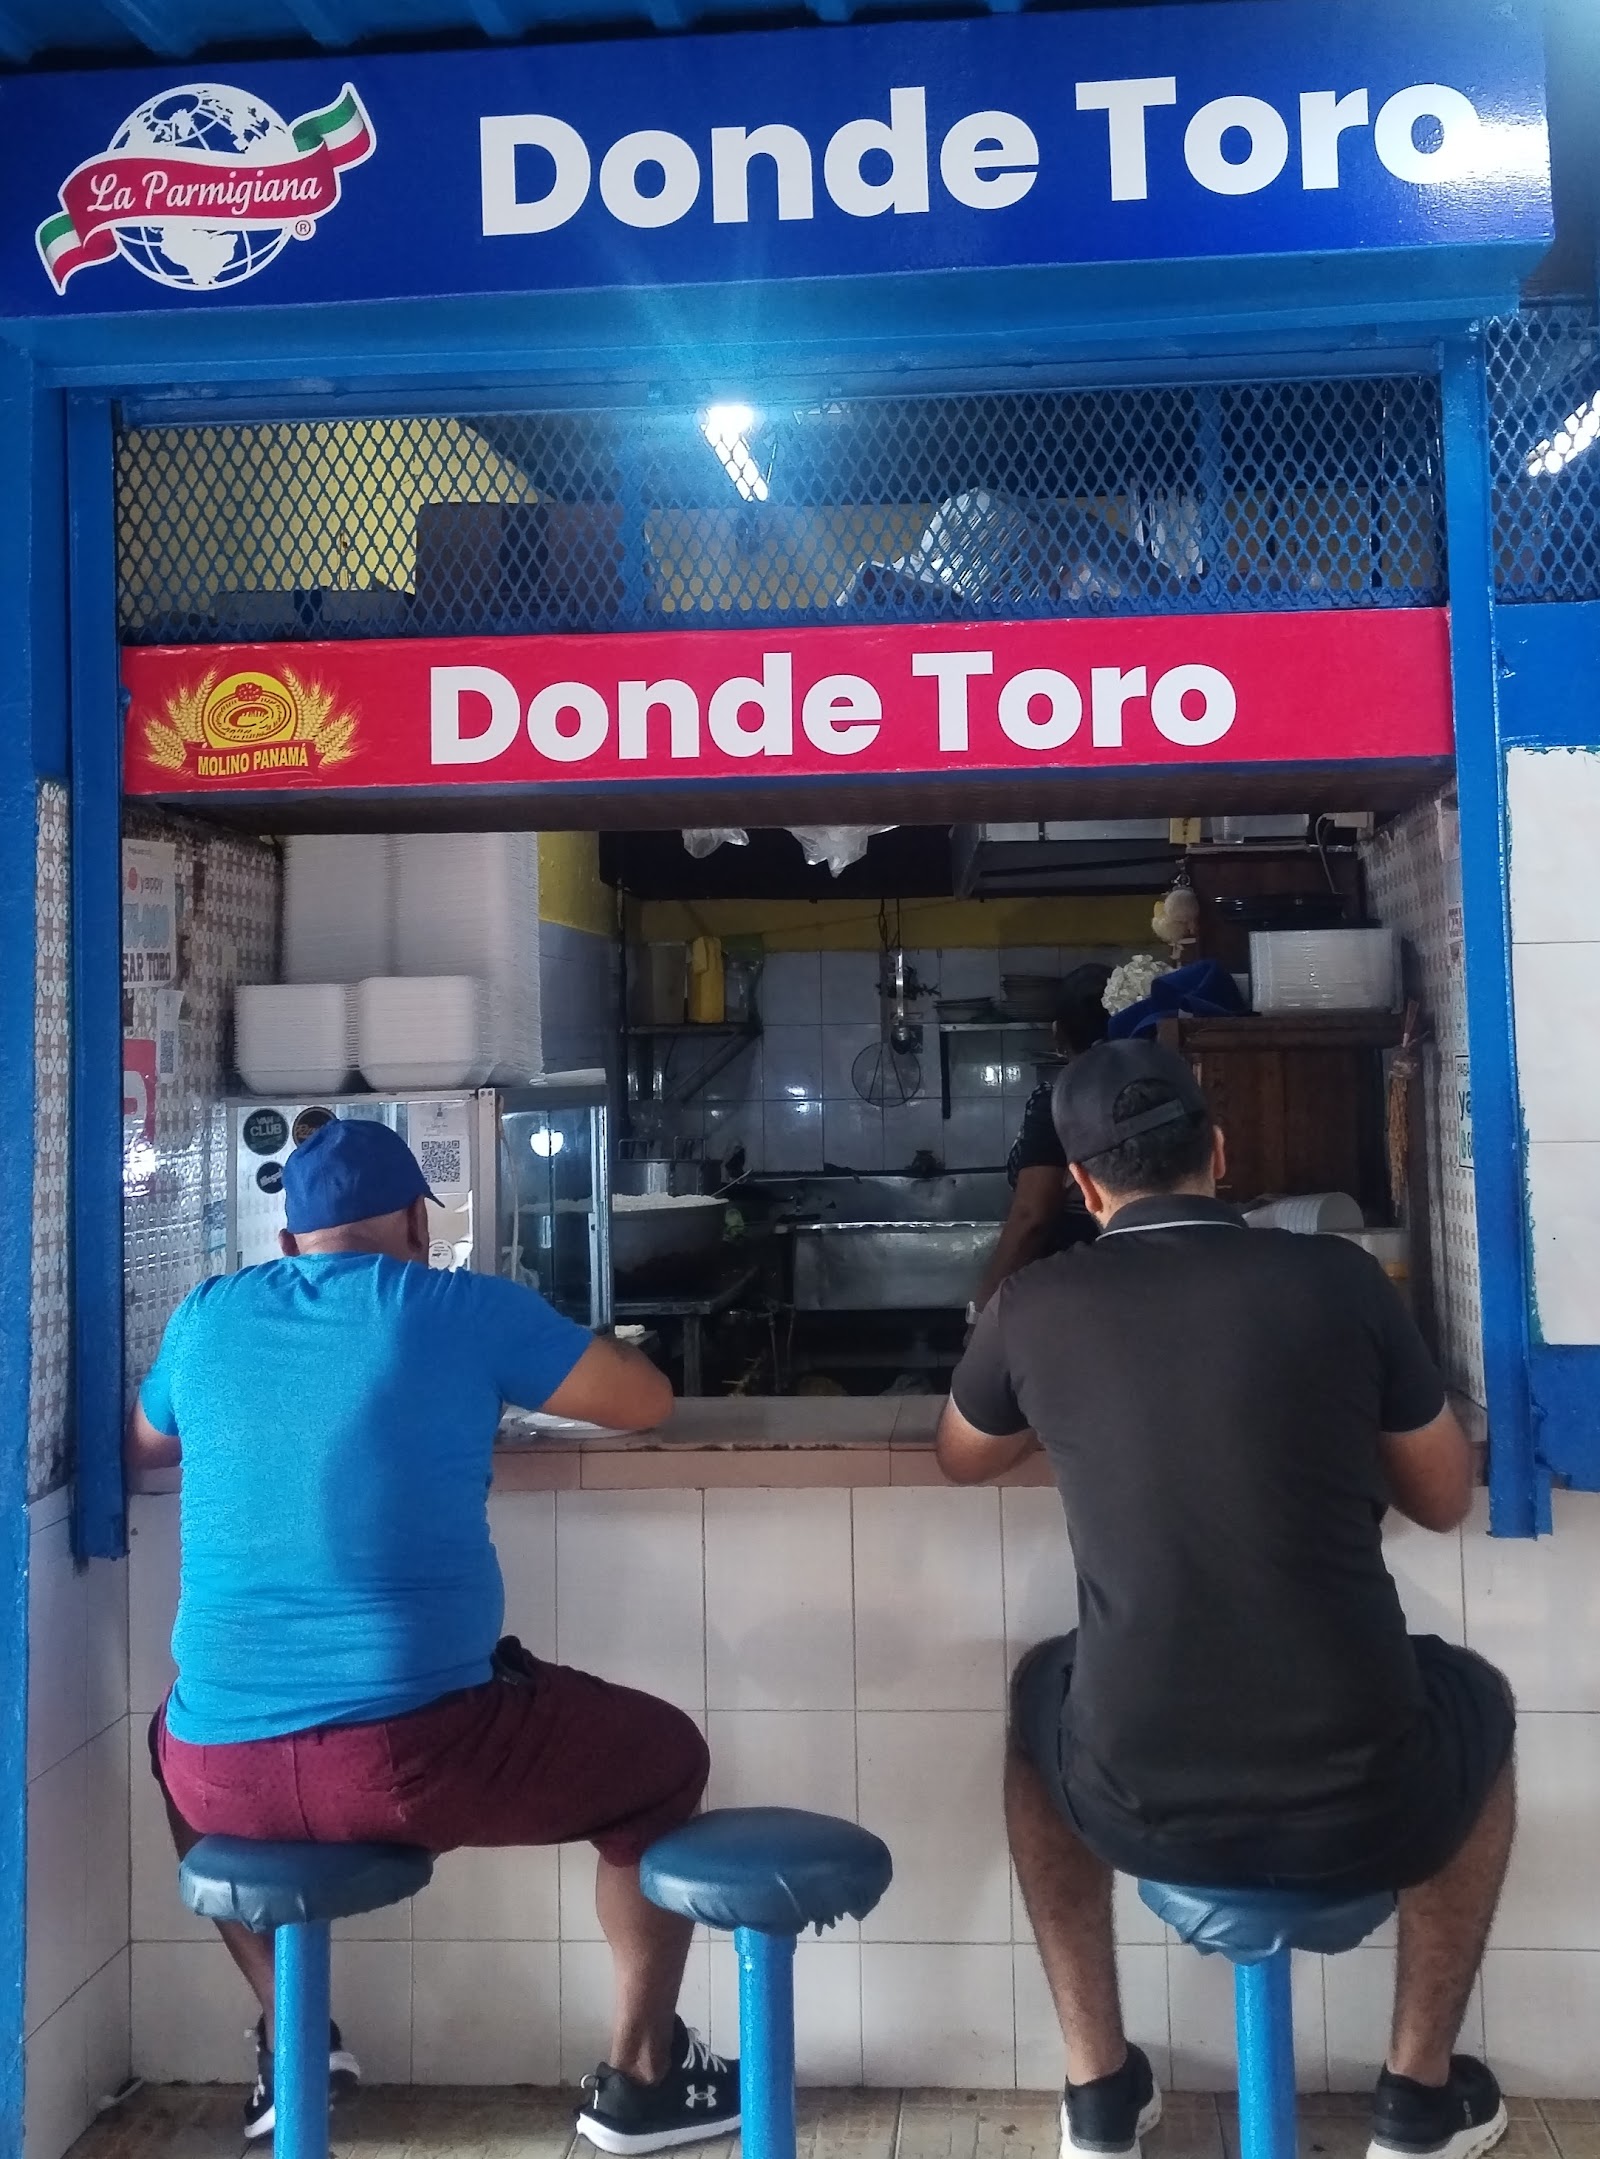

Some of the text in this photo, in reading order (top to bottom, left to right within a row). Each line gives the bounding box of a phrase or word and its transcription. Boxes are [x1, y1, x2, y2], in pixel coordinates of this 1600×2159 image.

[480, 77, 1479, 236] Donde Toro
[87, 169, 323, 216] La Parmigiana
[431, 652, 1236, 765] Donde Toro
[198, 743, 308, 776] MOLINO PANAMÁ
[147, 953, 171, 981] TORO
[250, 1123, 282, 1137] CLUB
